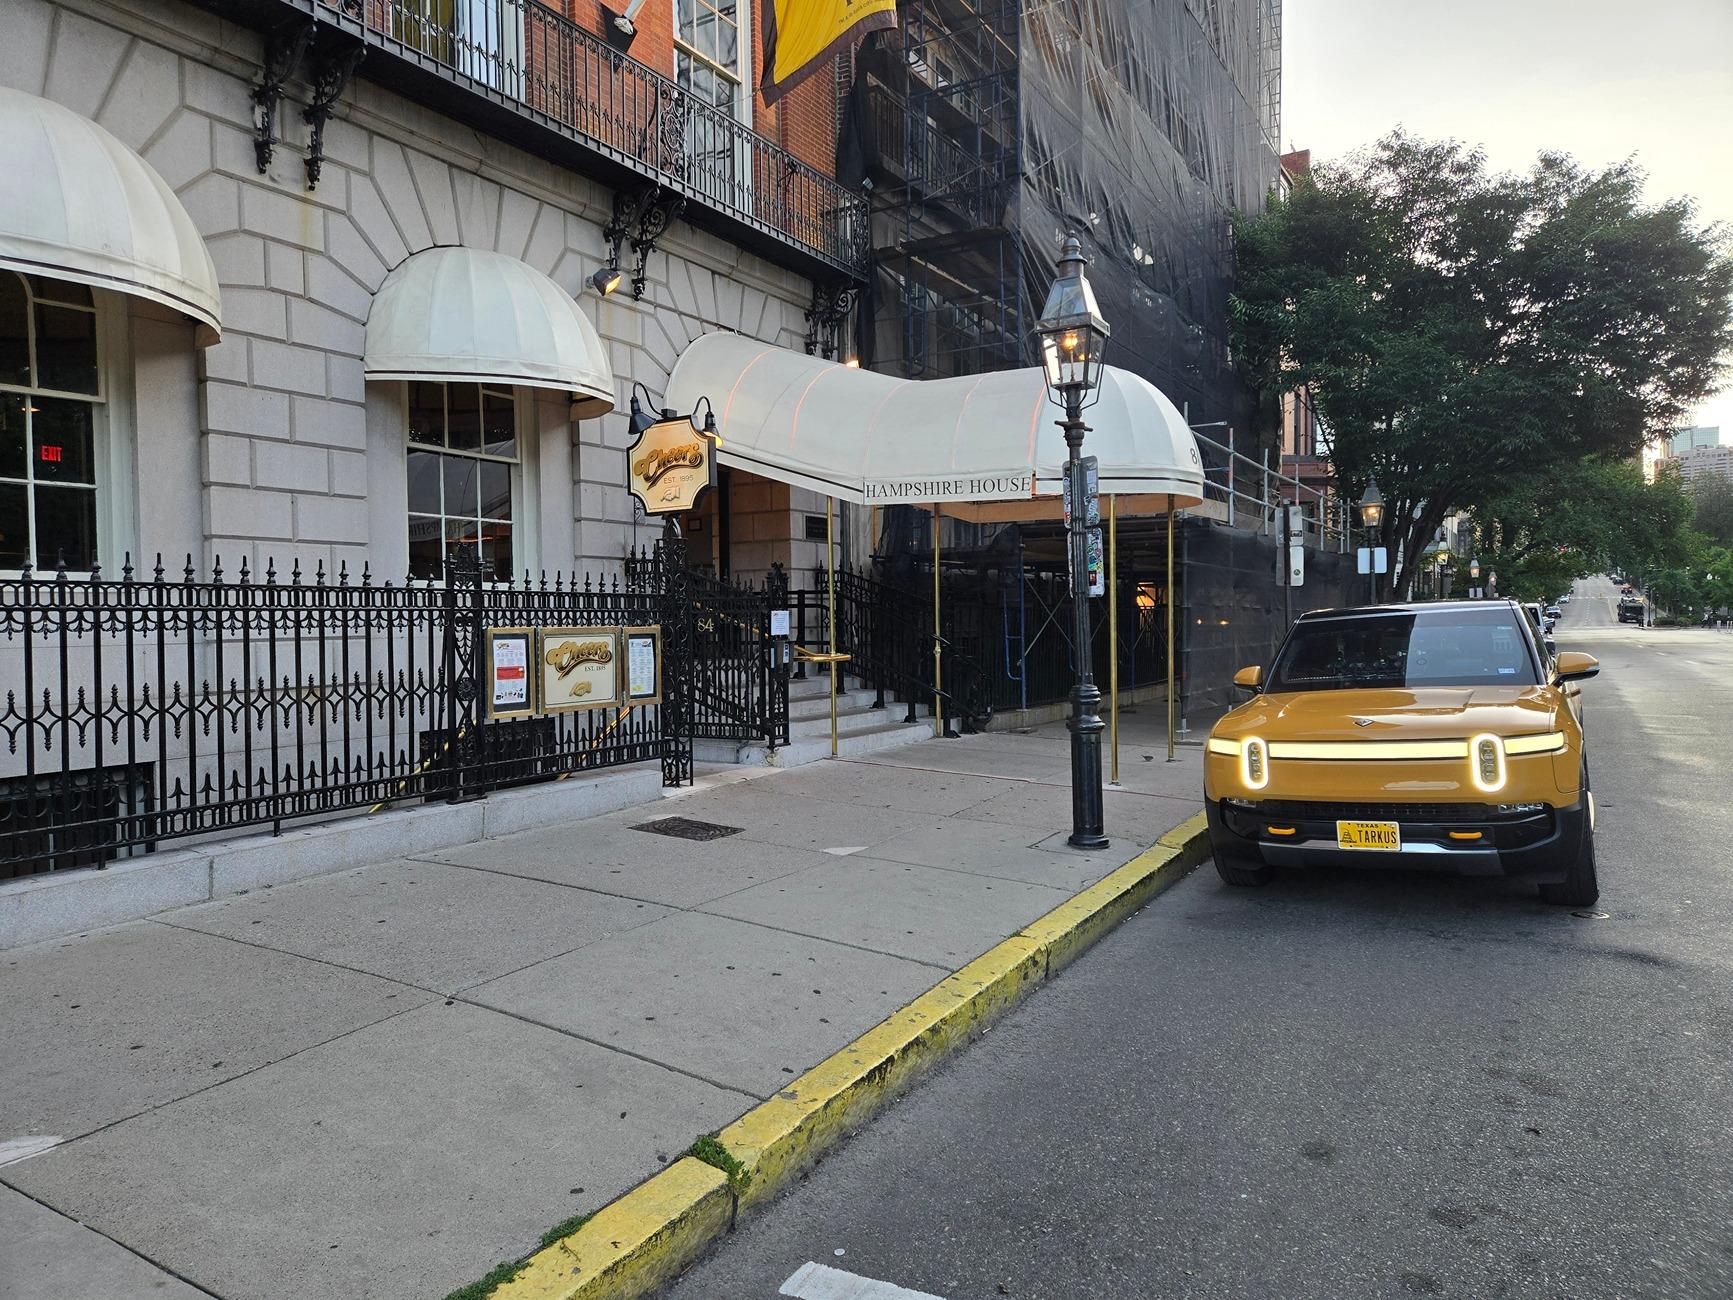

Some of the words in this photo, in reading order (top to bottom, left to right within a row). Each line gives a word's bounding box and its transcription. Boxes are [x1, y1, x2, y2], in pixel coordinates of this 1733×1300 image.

[41, 445, 63, 462] EXIT
[634, 443, 704, 491] Cheers
[866, 480, 964, 498] HAMPSHIRE
[970, 476, 1031, 494] HOUSE
[697, 618, 714, 632] 84
[546, 641, 612, 680] Cheers
[1357, 830, 1397, 844] TARKUS
